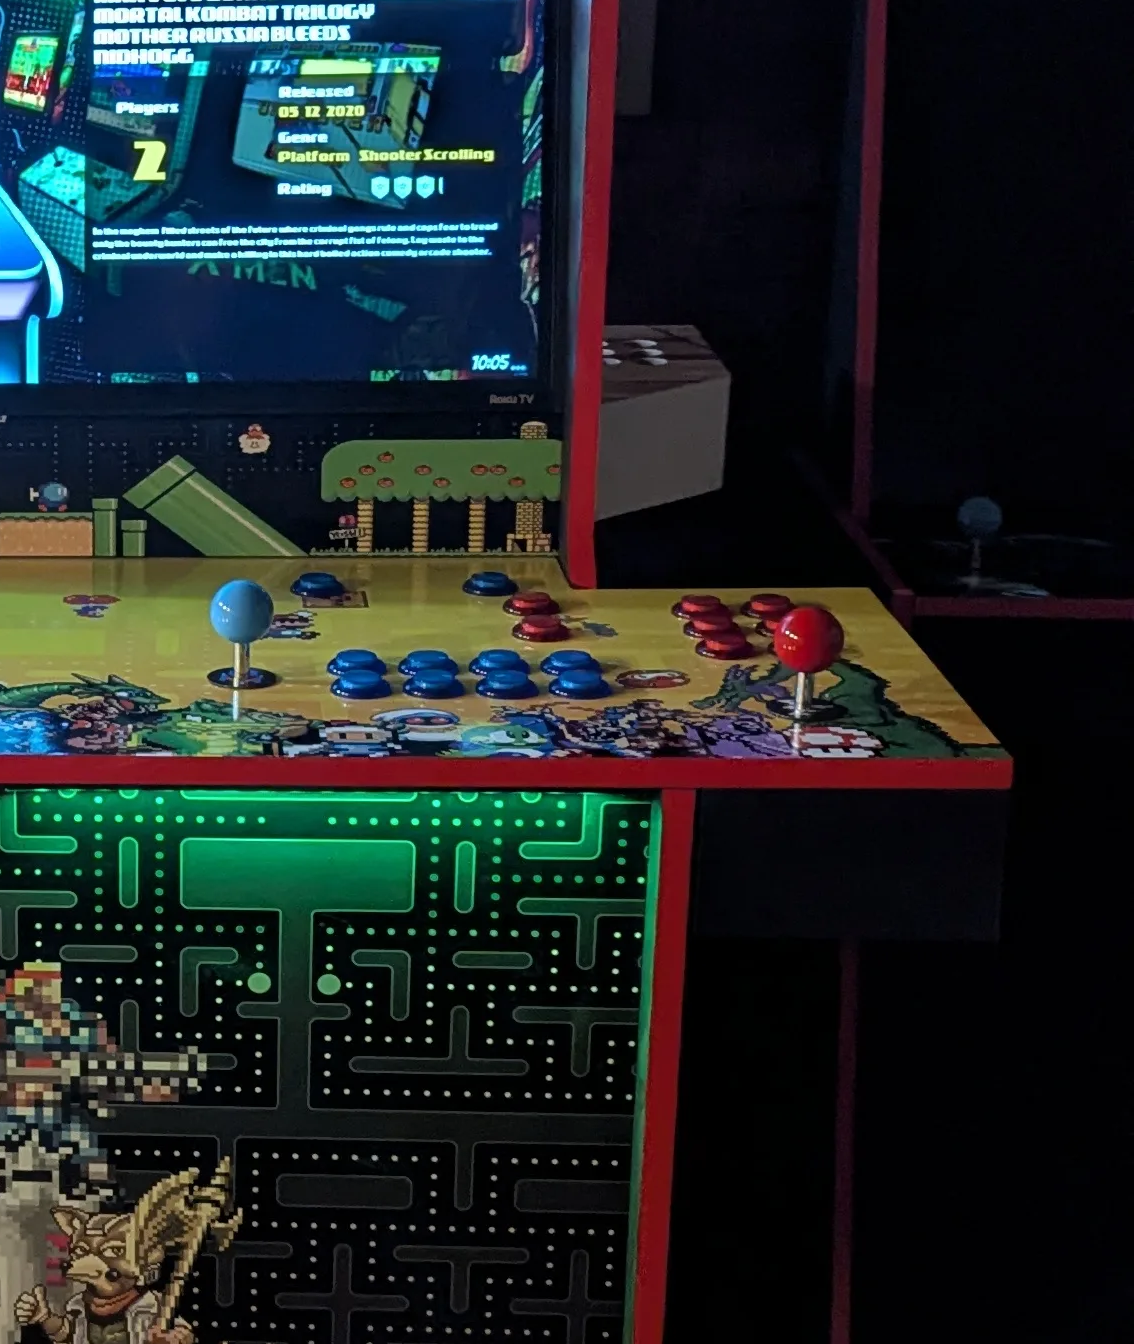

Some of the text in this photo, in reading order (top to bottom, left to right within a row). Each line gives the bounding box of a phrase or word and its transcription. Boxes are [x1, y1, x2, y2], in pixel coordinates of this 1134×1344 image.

[94, 4, 375, 24] MORTAL KOMBAT TRILOGY
[94, 26, 351, 45] MOTHER RUSSIA BLEEDS
[93, 48, 194, 65] NIDHOGG
[278, 85, 355, 98] Released
[115, 101, 179, 115] Players
[278, 105, 365, 118] 05 12 2020
[277, 131, 329, 144] Genre
[132, 141, 166, 181] 2
[277, 148, 495, 162] Platform Shooter Scrolling
[277, 182, 333, 197] Rating
[471, 354, 511, 371] 10:05
